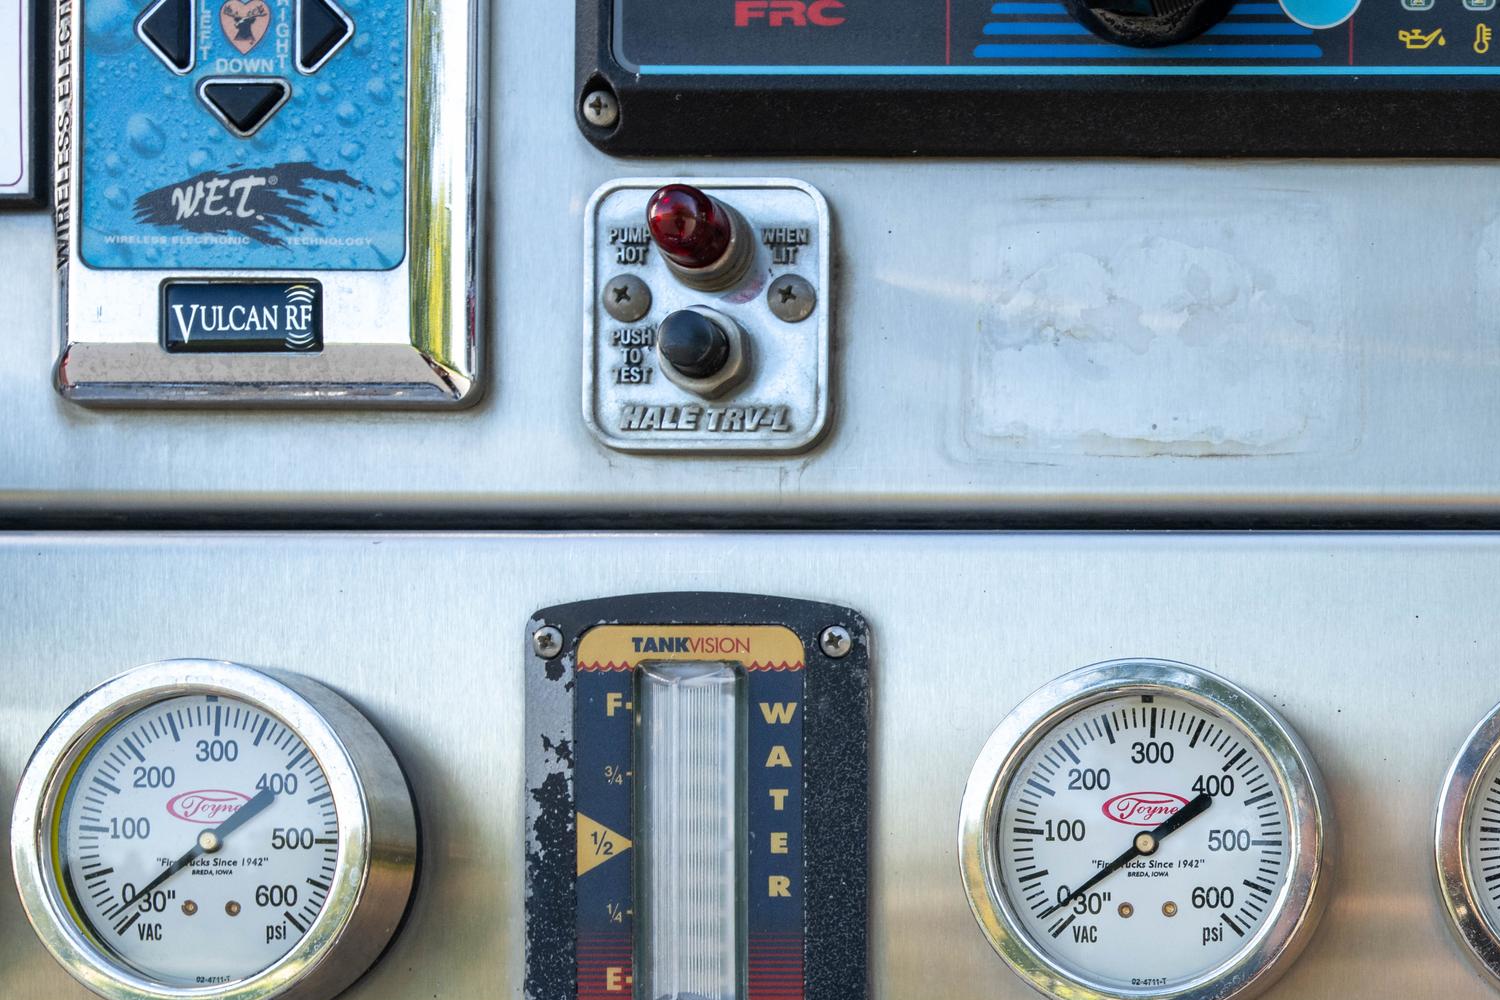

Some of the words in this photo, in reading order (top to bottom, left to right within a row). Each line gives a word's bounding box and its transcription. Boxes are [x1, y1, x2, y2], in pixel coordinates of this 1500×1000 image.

[733, 0, 845, 26] FRC
[216, 58, 274, 73] DOWN
[57, 111, 70, 270] WIRELESS
[104, 235, 167, 245] WIRELESS
[171, 235, 250, 246] ELECTRONIC
[287, 237, 373, 246] TECHNOLOGY
[609, 228, 651, 243] PUMP
[761, 228, 808, 244] WHEN
[617, 247, 648, 264] HOT
[773, 247, 798, 264] LIT
[285, 304, 313, 331] RF
[612, 329, 653, 346] PUSH
[623, 349, 642, 365] TO
[614, 367, 652, 384] TEST
[621, 405, 702, 431] HALE
[708, 405, 790, 432] TRV-L
[606, 692, 623, 716] F
[195, 740, 238, 762] 300
[1131, 742, 1174, 764] 300
[133, 766, 176, 788] 200
[255, 773, 298, 795] 400
[604, 765, 623, 785] 3/4
[1068, 768, 1111, 791] 200
[1192, 775, 1235, 797] 400
[761, 701, 798, 898] WATER
[1117, 797, 1179, 820] Toyne
[111, 817, 150, 839] 100
[271, 828, 314, 850] 500
[1045, 819, 1086, 841] 100
[591, 830, 614, 856] 1/2
[1208, 829, 1250, 851] 500
[213, 857, 238, 867] Since
[242, 857, 269, 867] 1942"
[1149, 859, 1174, 869] Since
[1178, 859, 1205, 869] 1942"
[121, 883, 135, 903] 0
[138, 890, 176, 913] 30"
[256, 885, 298, 907] 600
[1073, 892, 1111, 915] 30"
[1192, 887, 1234, 909] 600
[606, 903, 623, 923] 1/4
[138, 923, 162, 941] VAC
[266, 922, 287, 944] psi
[1073, 925, 1097, 944] VAC
[1202, 923, 1223, 946] psi
[606, 967, 622, 991] E
